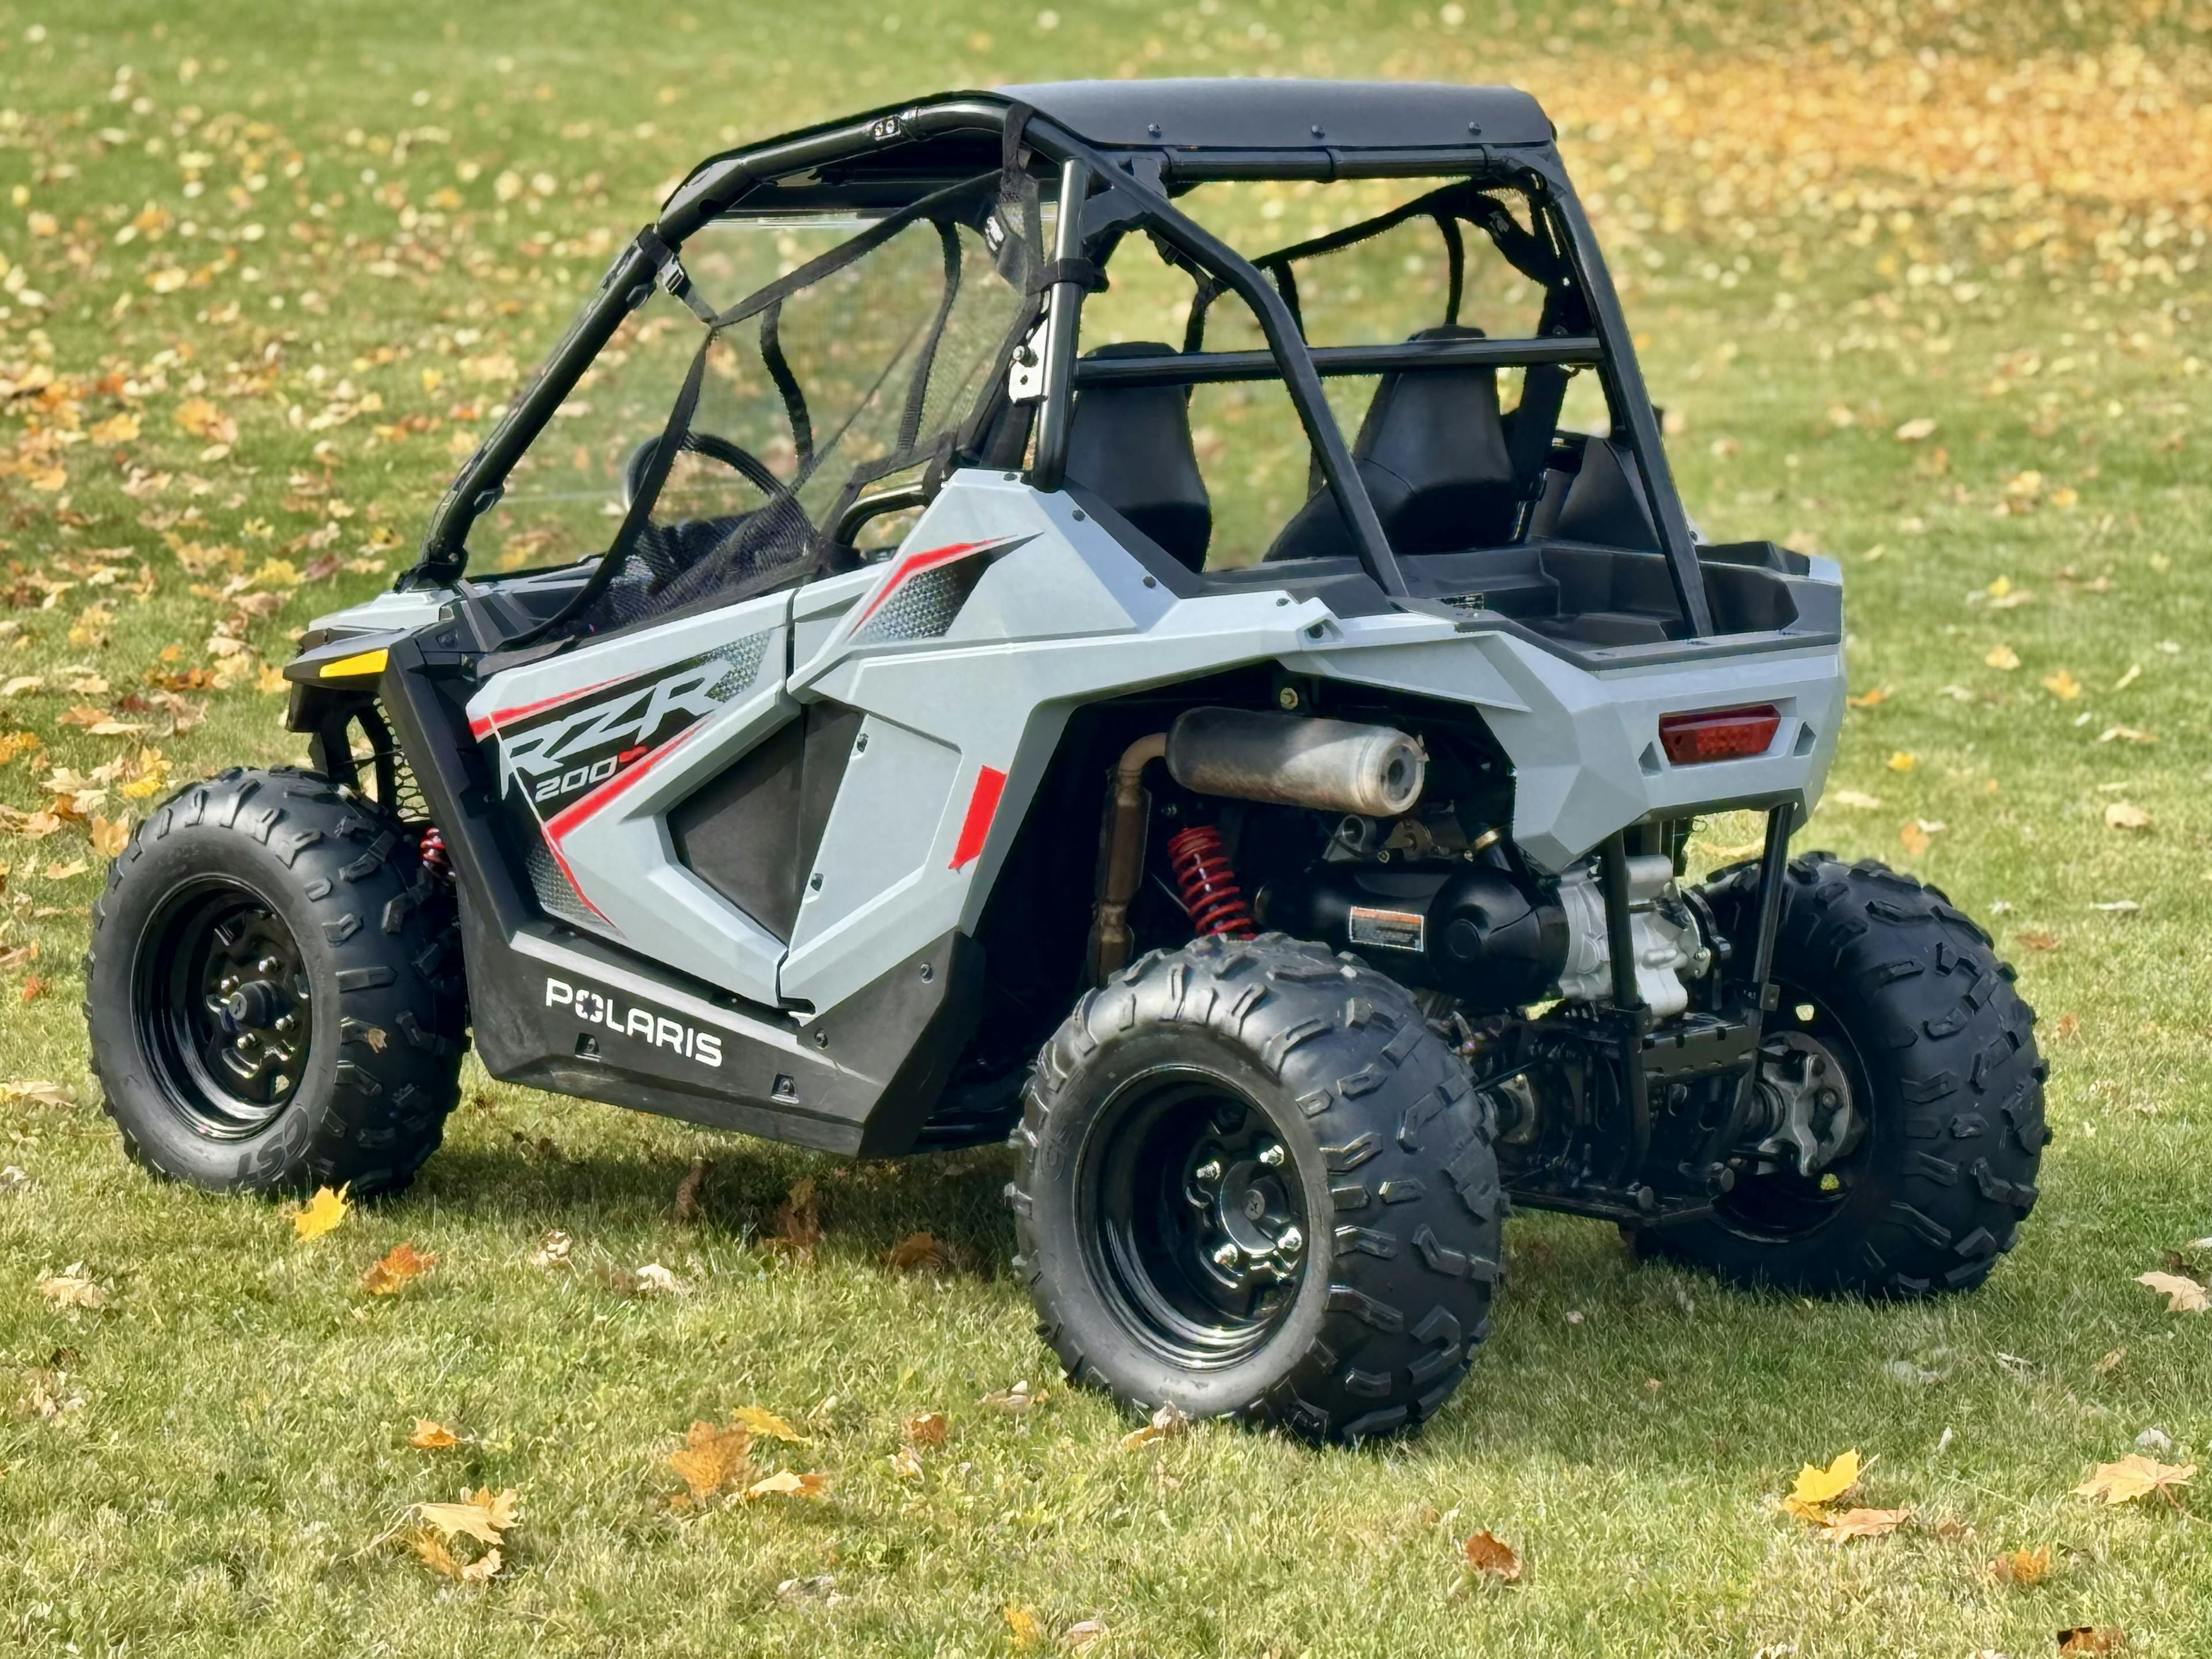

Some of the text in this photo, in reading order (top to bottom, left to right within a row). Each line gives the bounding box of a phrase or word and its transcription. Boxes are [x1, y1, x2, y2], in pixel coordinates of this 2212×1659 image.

[499, 657, 733, 801] RZR
[535, 755, 618, 803] 200
[546, 978, 722, 1067] POLARIS
